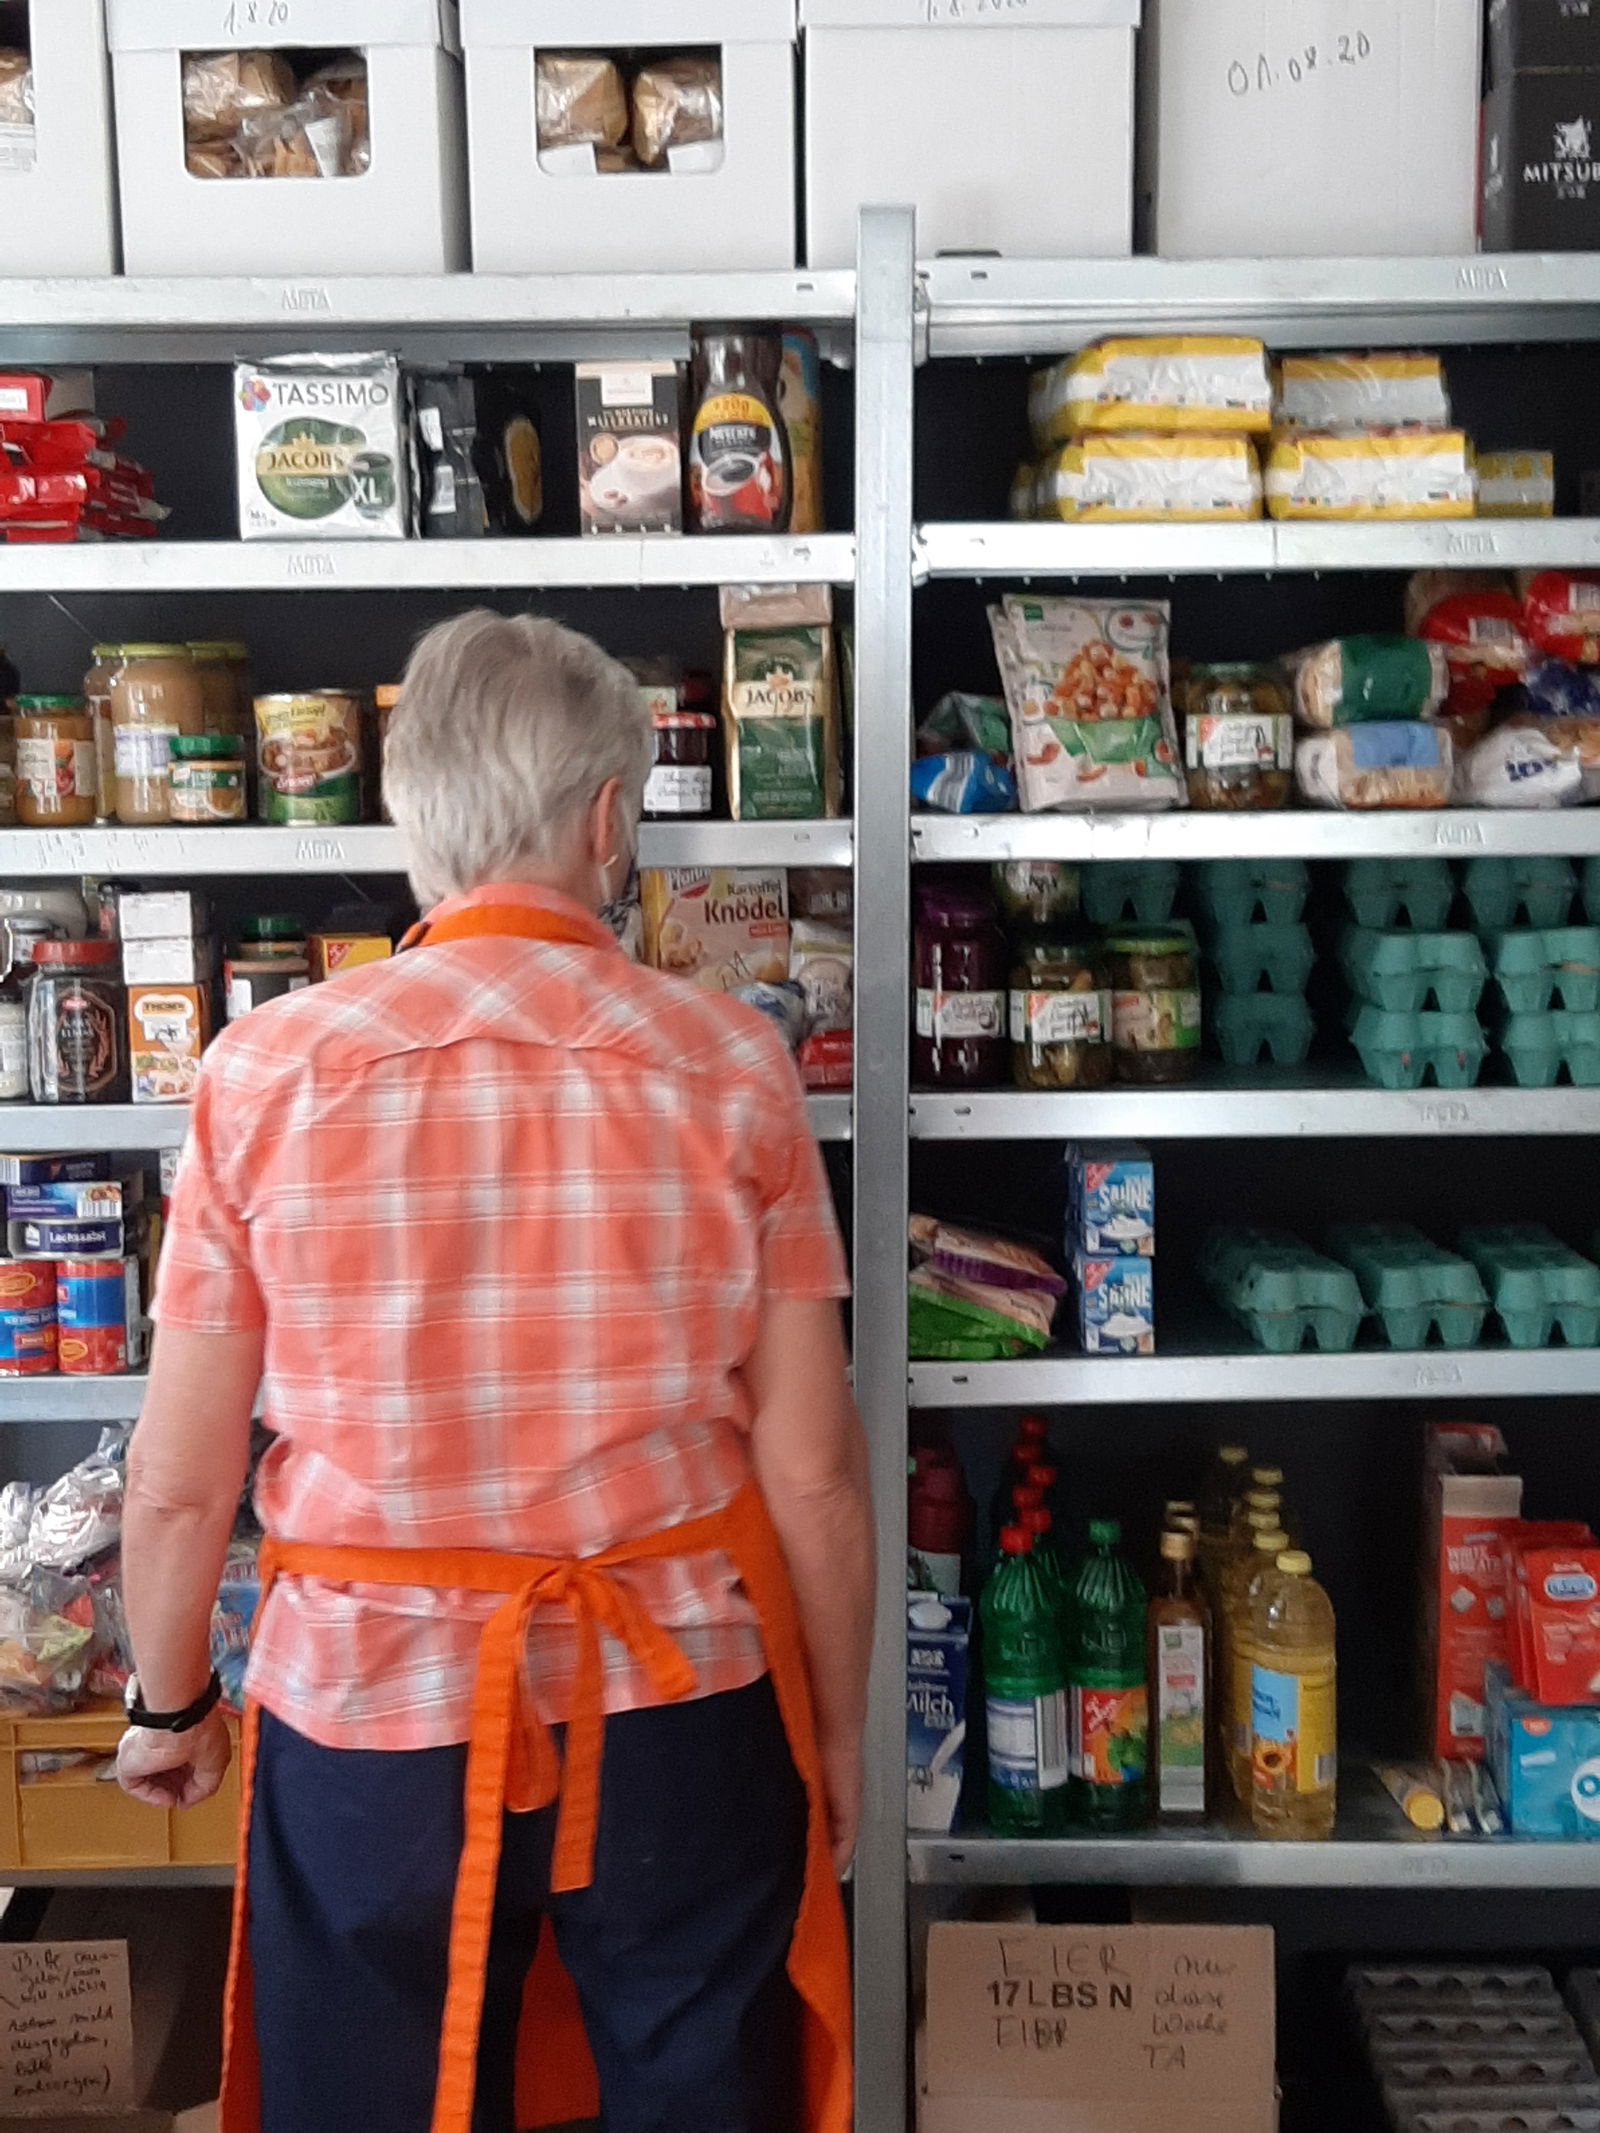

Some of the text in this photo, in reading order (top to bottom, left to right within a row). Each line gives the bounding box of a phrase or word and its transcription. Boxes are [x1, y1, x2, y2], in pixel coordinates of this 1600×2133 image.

[273, 382, 389, 406] TASSIMO
[267, 449, 344, 471] JACOBS
[351, 477, 383, 505] XL
[745, 687, 816, 707] JACOBS
[703, 895, 785, 925] Knödel
[1099, 1176, 1151, 1213] SAHNE
[1098, 1274, 1151, 1312] SAHNE
